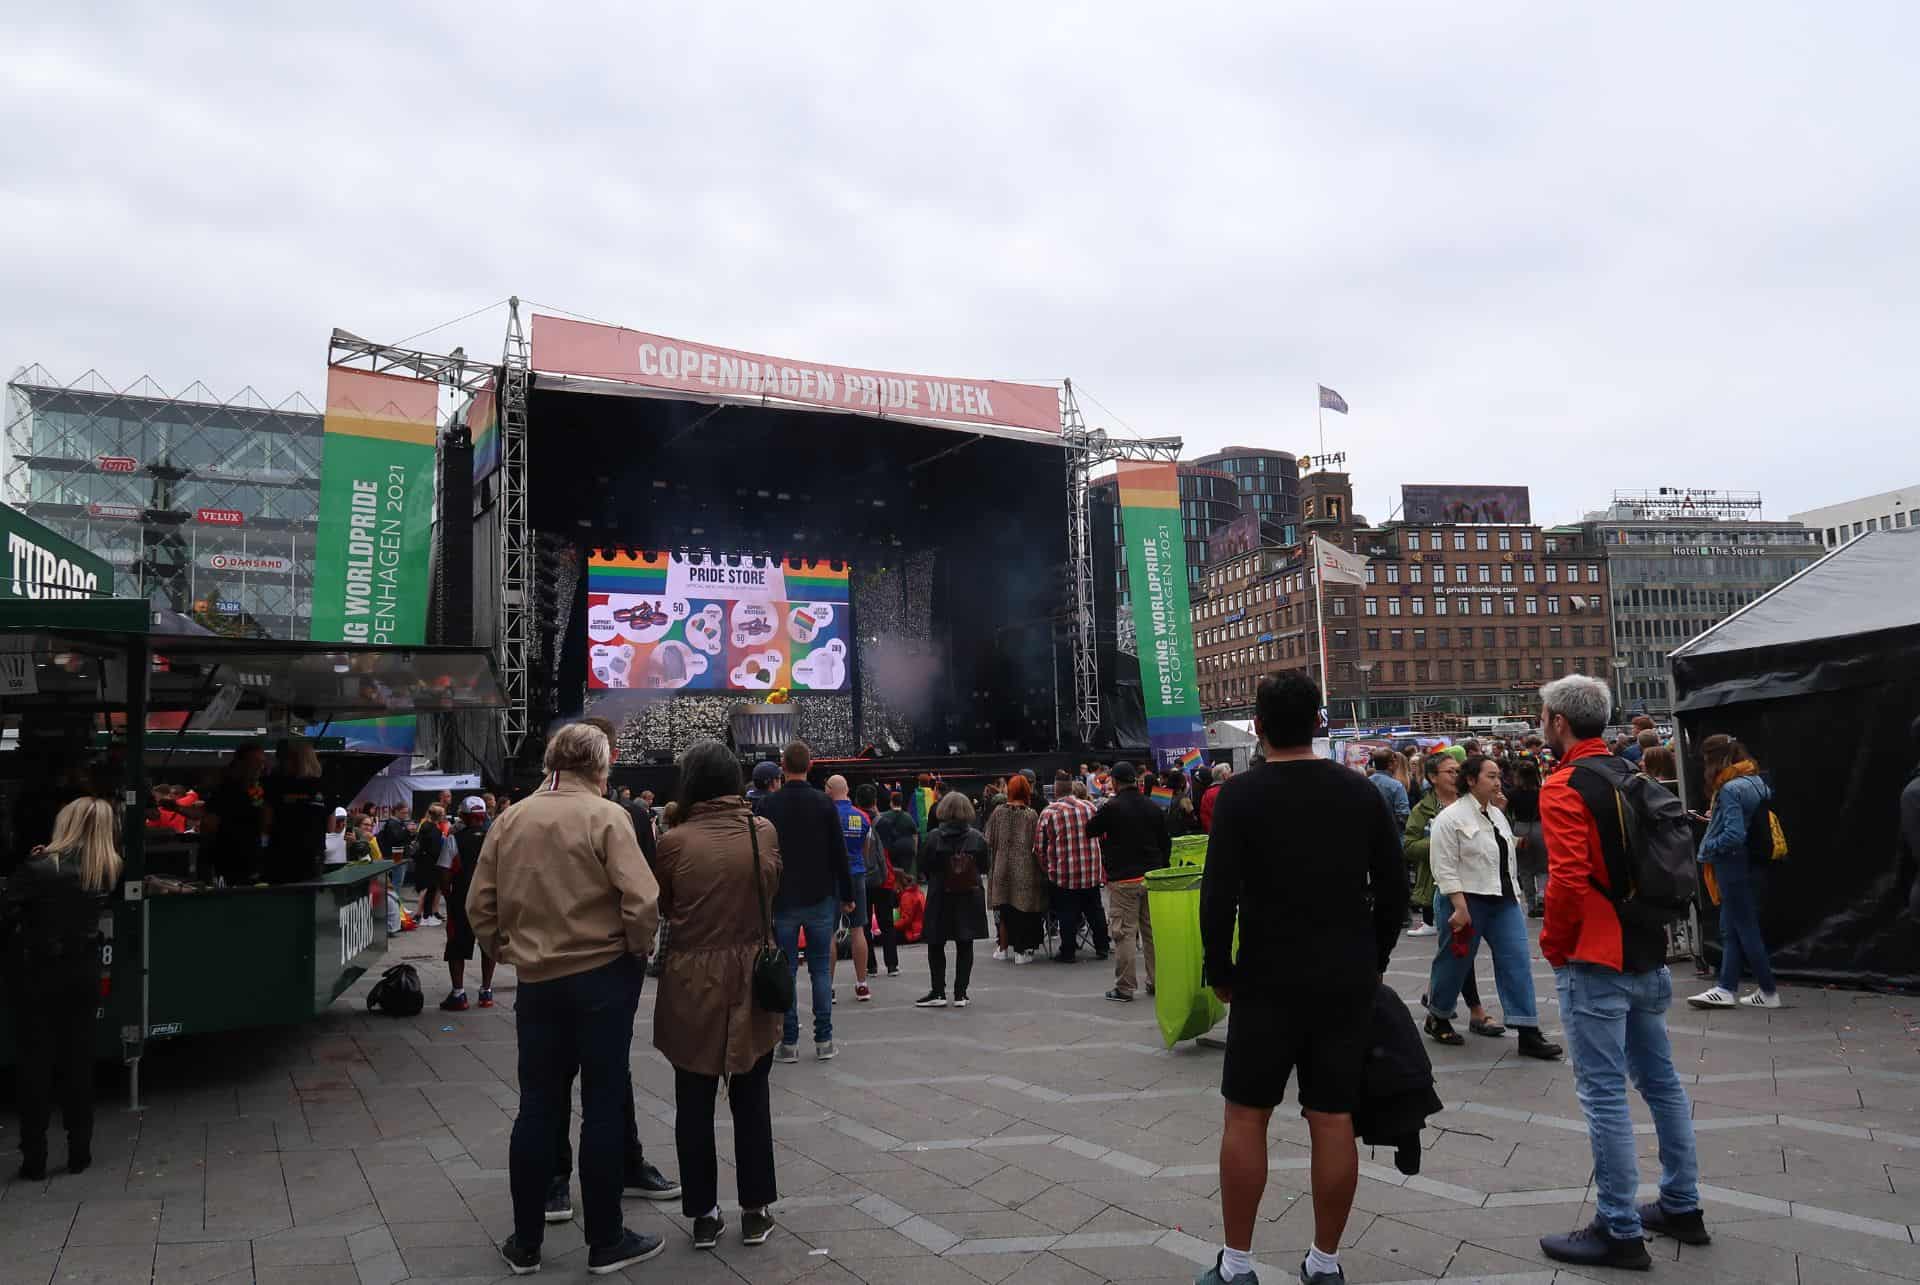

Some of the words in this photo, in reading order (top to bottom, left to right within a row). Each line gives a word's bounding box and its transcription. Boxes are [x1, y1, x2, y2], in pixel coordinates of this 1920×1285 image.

[638, 343, 836, 400] COPENHAGEN
[843, 372, 919, 409] PRIDE
[925, 381, 994, 417] WEEK
[1311, 451, 1346, 466] THAI
[387, 465, 405, 512] 2021
[202, 510, 240, 522] VELUX
[345, 480, 378, 616] WORLDPRIDE
[1158, 525, 1172, 559] 2021
[1672, 546, 1700, 555] Hotel
[1710, 546, 1729, 555] The
[1732, 546, 1765, 557] Square
[230, 558, 283, 569] DANSAND
[689, 567, 725, 583] PRIDE
[728, 569, 765, 585] STORE
[1144, 537, 1168, 637] WORLDPRIDE
[1162, 563, 1182, 682] COPENHAGEN
[1156, 639, 1173, 705] HOSTING
[1174, 686, 1185, 704] IN
[339, 894, 374, 966] TUBORG
